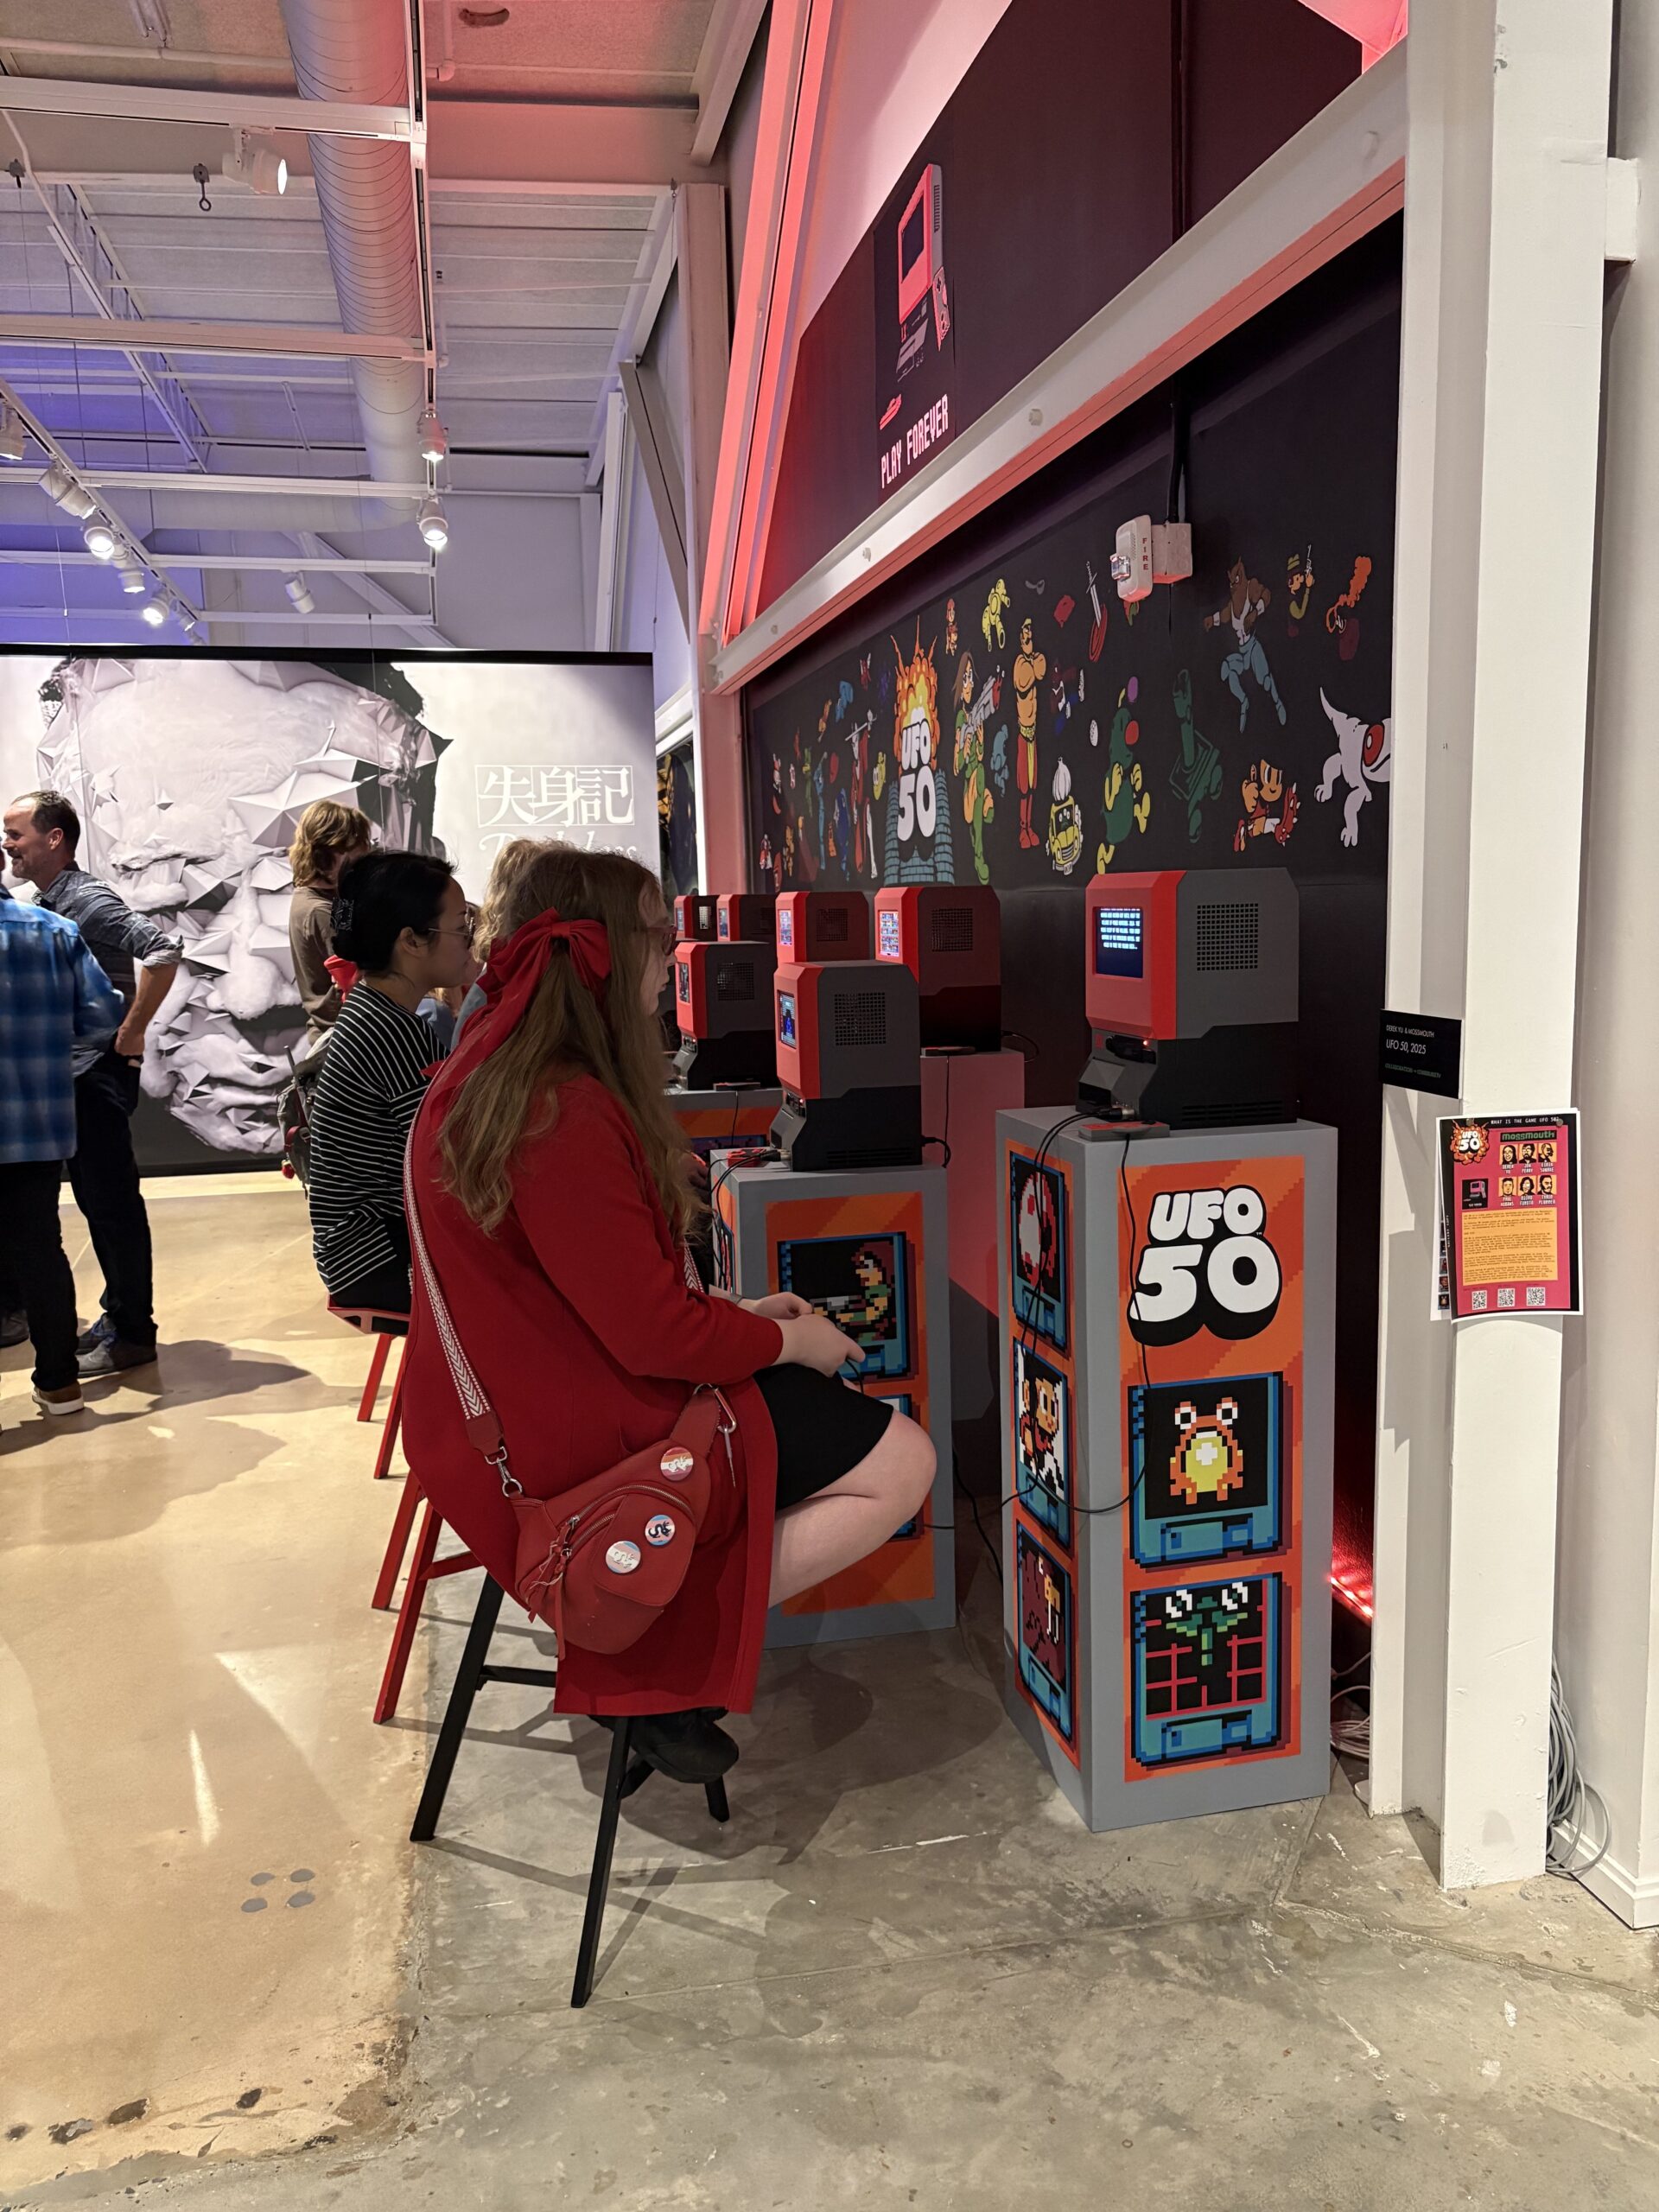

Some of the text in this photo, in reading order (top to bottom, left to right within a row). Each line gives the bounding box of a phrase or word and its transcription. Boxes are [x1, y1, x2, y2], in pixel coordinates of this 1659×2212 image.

[880, 393, 949, 489] PLAY FOREVER
[901, 719, 931, 771] UFO
[478, 766, 635, 827] 失身記
[897, 765, 937, 842] 50
[1386, 1039, 1427, 1054] UFO 50, 2025
[1408, 1028, 1434, 1037] MOSSMOUTH
[1459, 1138, 1480, 1151] 50
[1462, 1130, 1478, 1140] UFO
[1502, 1131, 1555, 1141] mossmouth
[1149, 1187, 1264, 1242] UFO
[1128, 1236, 1280, 1323] 50
